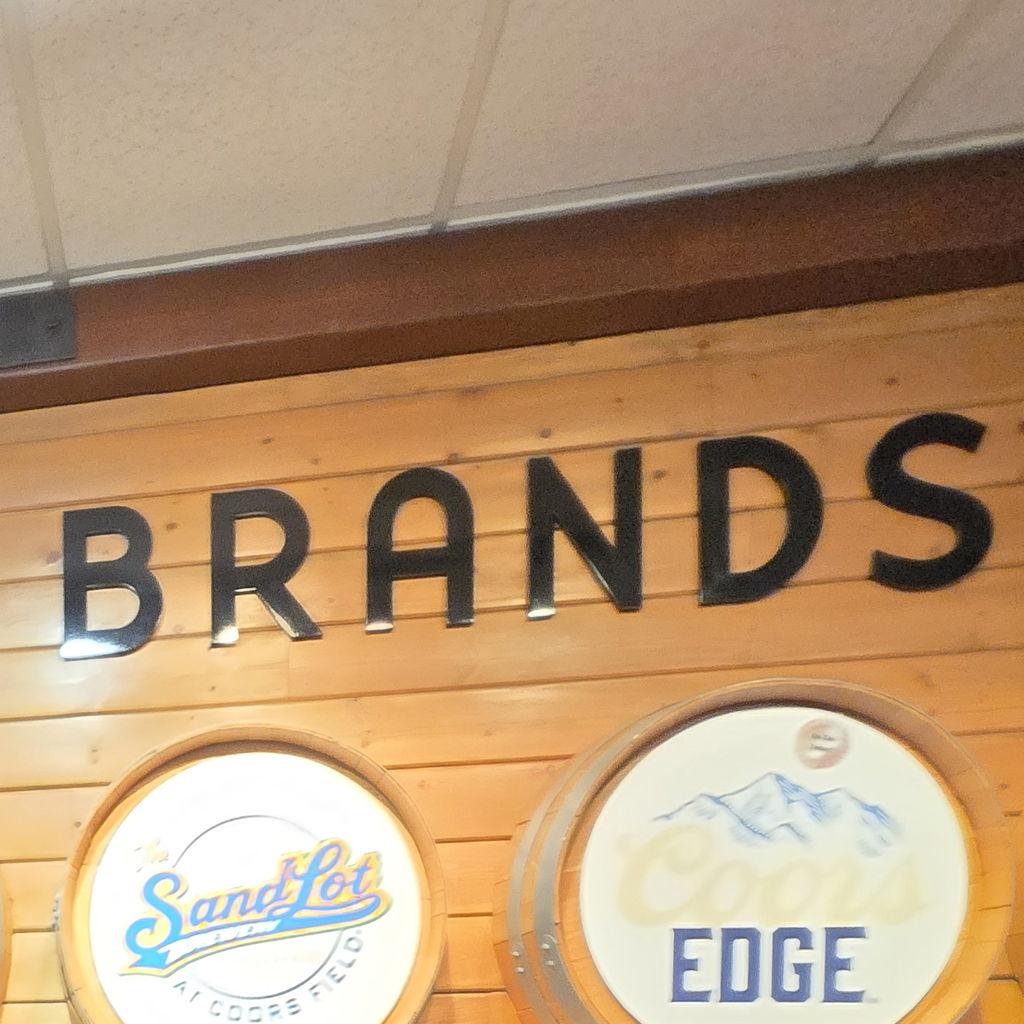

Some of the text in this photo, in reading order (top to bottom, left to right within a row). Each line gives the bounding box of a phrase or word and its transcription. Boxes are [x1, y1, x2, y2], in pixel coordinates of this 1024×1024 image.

[58, 411, 995, 662] BRANDS
[617, 823, 929, 927] Coors
[208, 997, 302, 1023] COORS
[670, 926, 869, 1004] EDGE
